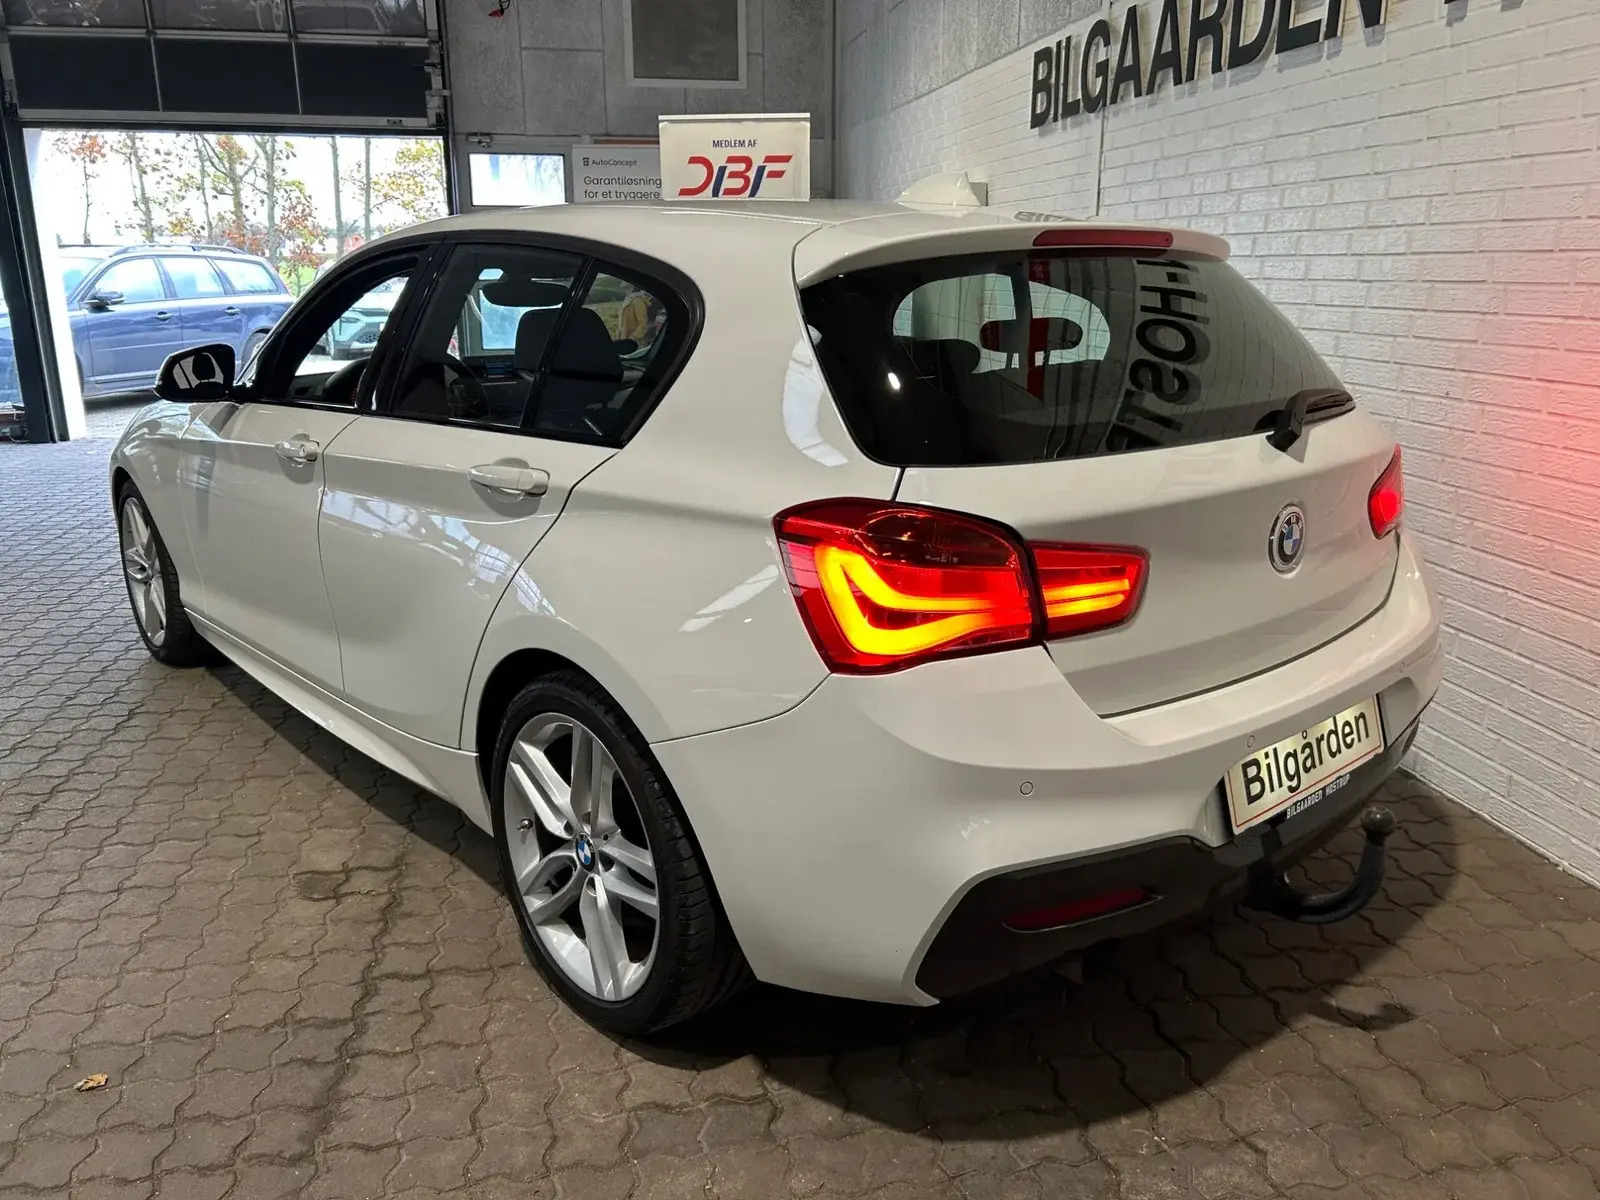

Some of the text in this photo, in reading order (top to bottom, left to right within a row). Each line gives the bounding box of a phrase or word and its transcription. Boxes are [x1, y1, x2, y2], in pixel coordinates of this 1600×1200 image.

[712, 139, 758, 148] MEDLEM AF
[591, 159, 638, 167] AutoConcept
[583, 176, 662, 189] Garantiløsning
[678, 154, 794, 198] DBF
[584, 189, 599, 199] for
[601, 189, 612, 199] et
[1241, 711, 1370, 806] Bilgården
[1286, 789, 1323, 819] BILGAARDEN
